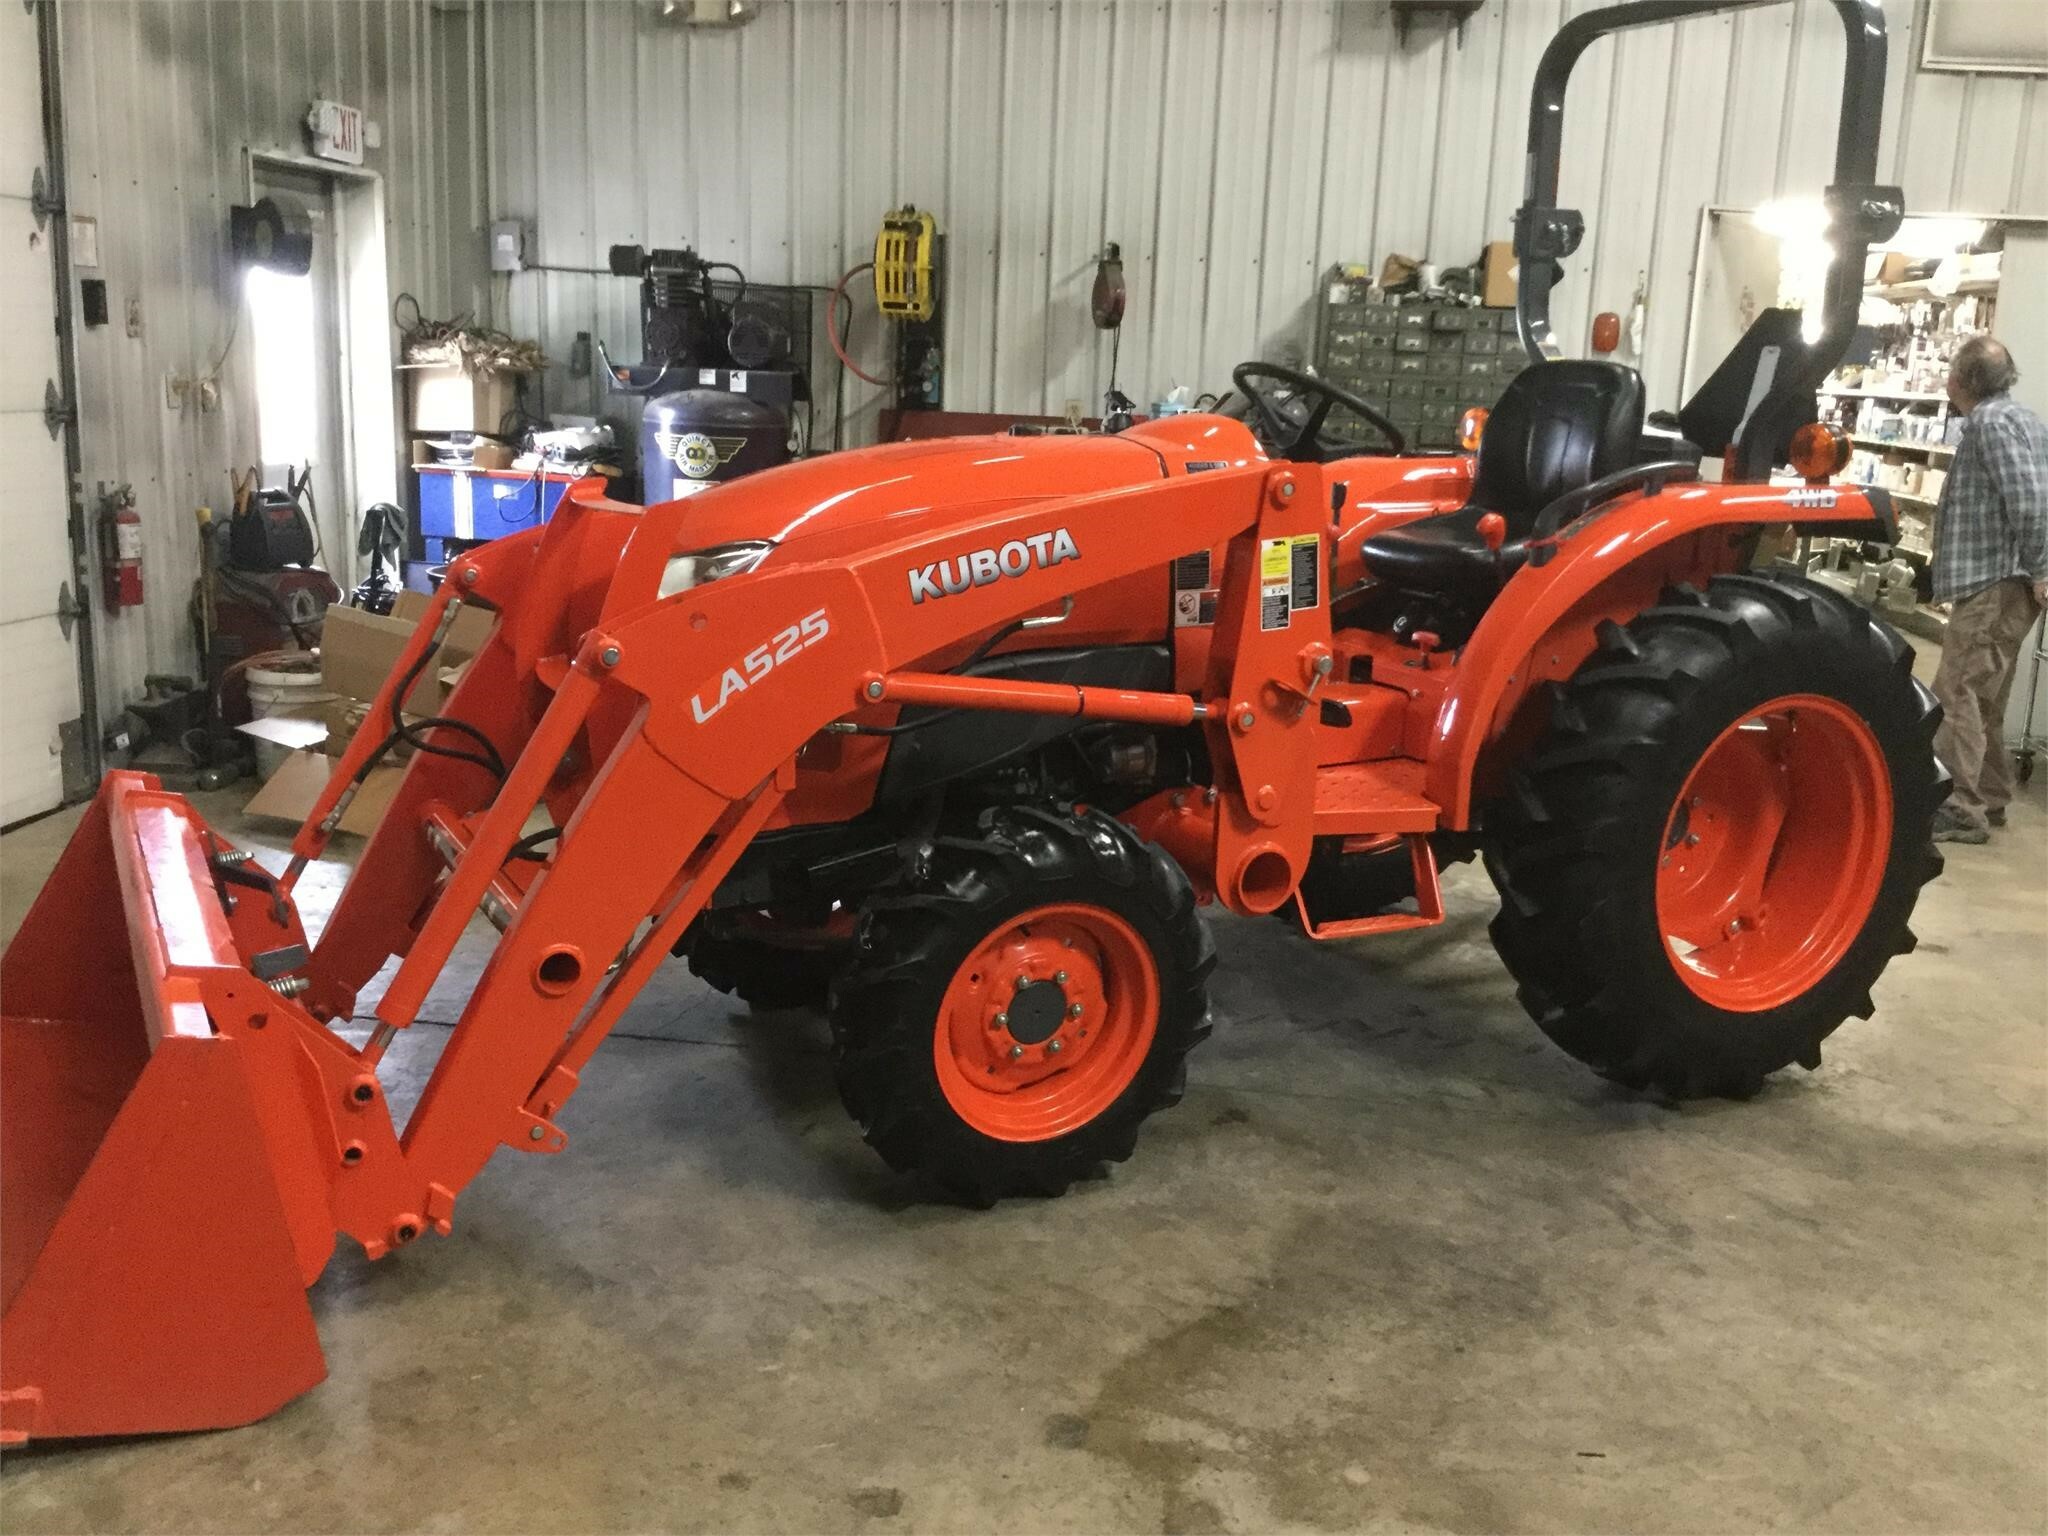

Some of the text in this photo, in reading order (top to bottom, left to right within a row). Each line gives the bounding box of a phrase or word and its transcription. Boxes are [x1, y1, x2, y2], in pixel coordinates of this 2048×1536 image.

[682, 435, 712, 448] QUINCY
[679, 453, 688, 466] AIR
[689, 454, 715, 473] MASTER
[1785, 489, 1838, 508] 4WD
[908, 527, 1081, 605] KUBOTA
[690, 608, 829, 724] LA525
